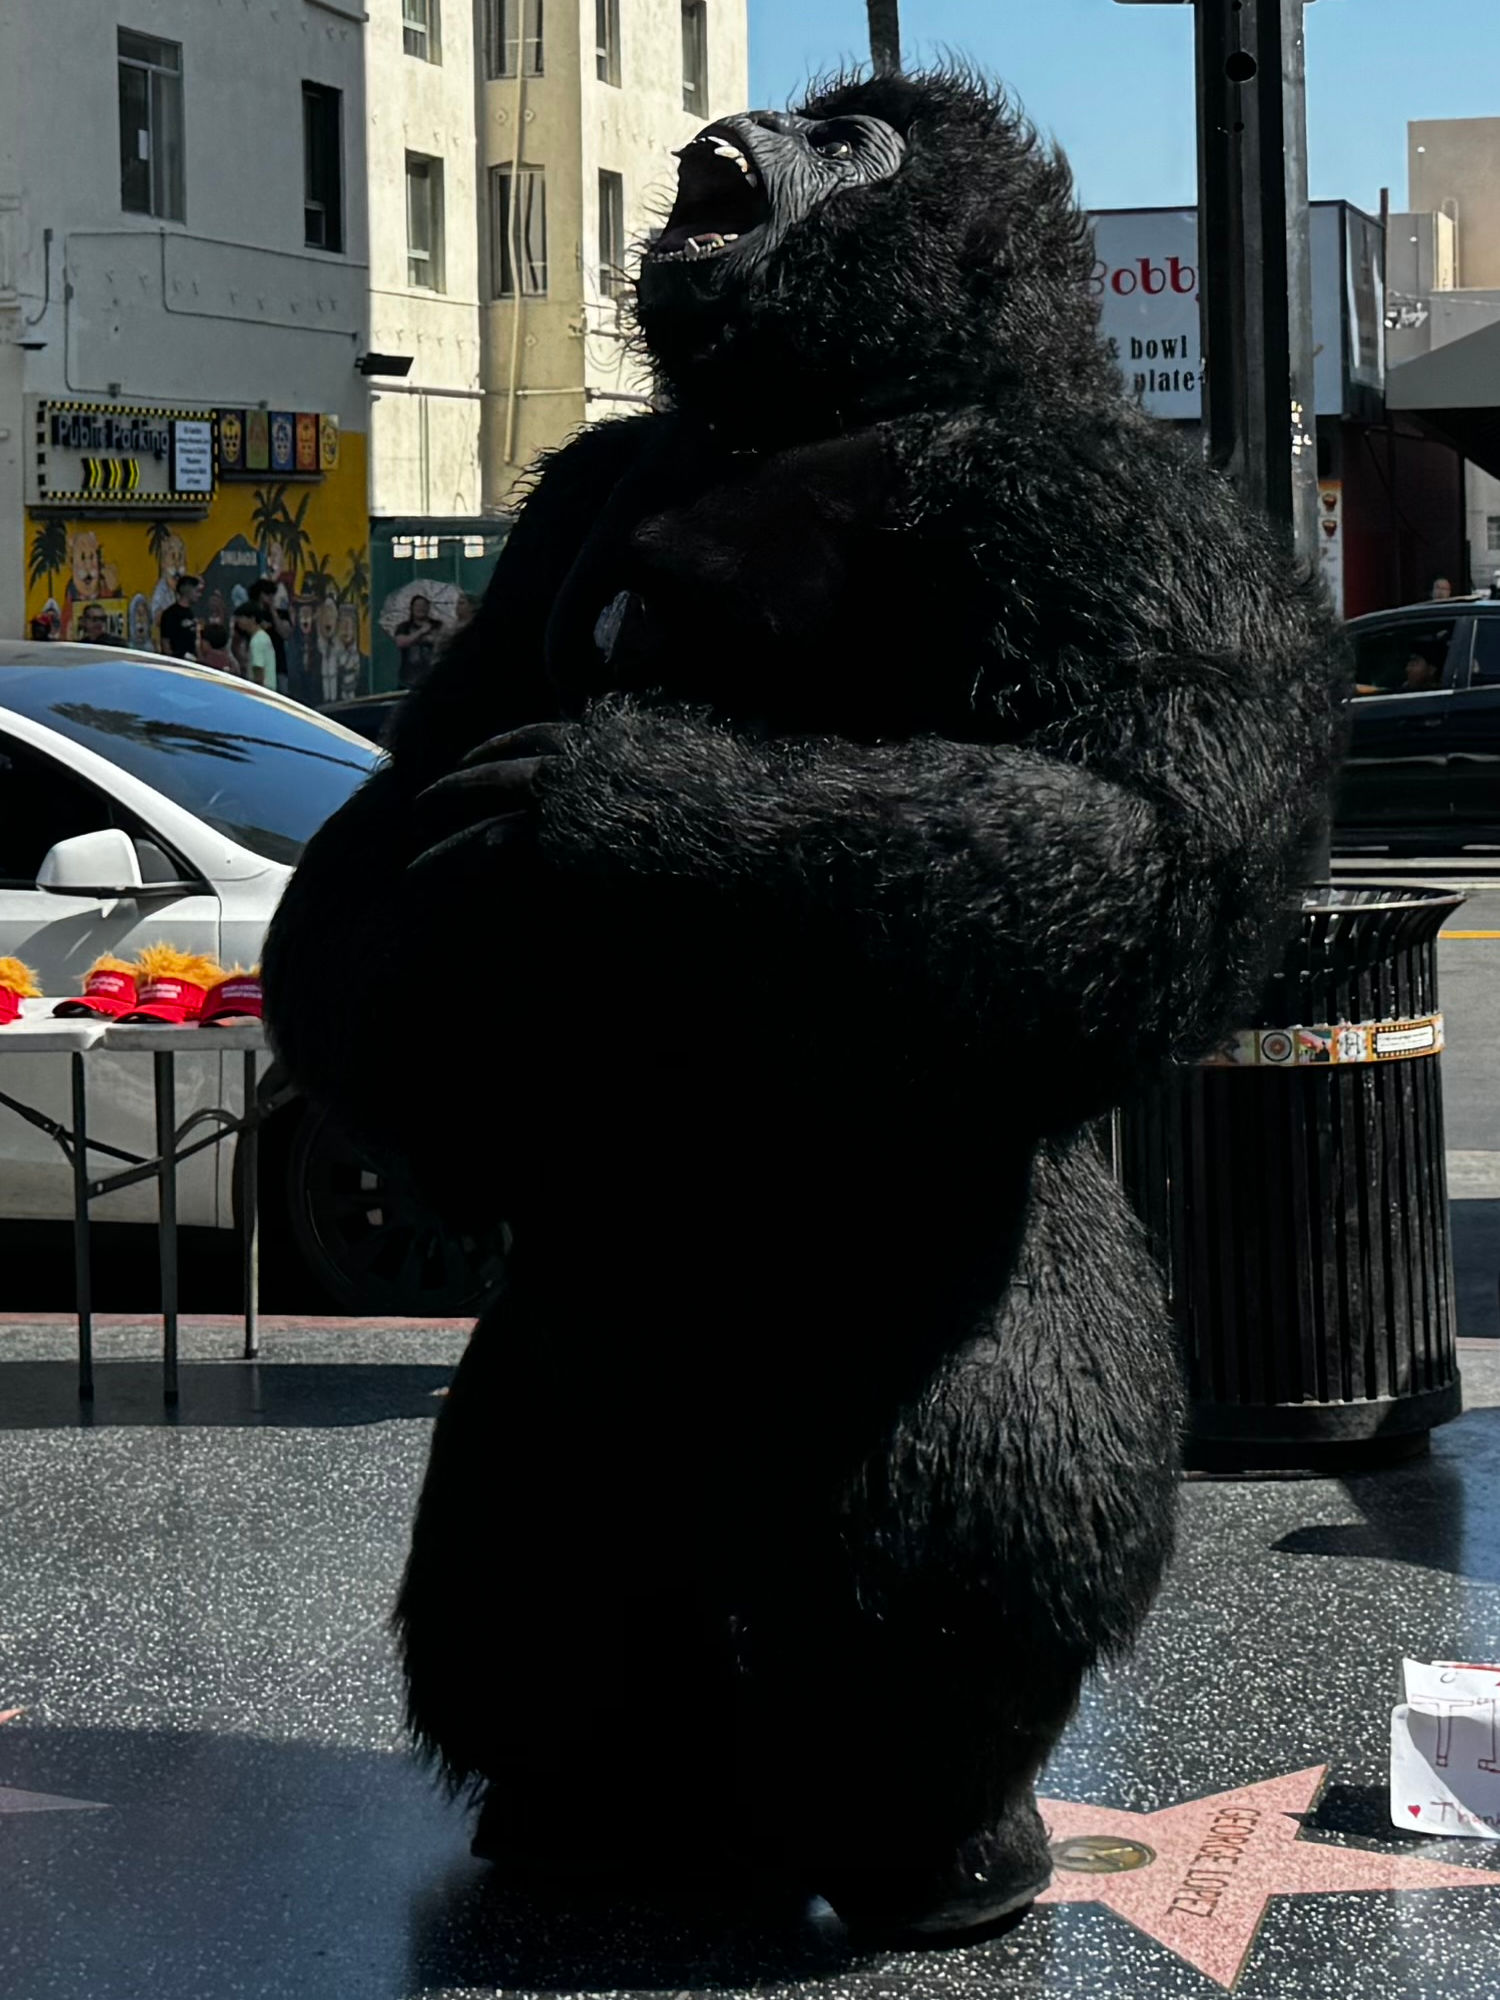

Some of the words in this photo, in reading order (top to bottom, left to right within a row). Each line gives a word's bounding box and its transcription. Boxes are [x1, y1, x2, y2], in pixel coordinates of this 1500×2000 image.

[1090, 256, 1200, 302] Bobb
[1131, 335, 1187, 359] bowl
[1134, 369, 1204, 396] plate
[59, 414, 107, 448] Public
[112, 418, 170, 457] Parking
[1189, 1807, 1262, 1865] GEORGE
[1165, 1869, 1233, 1917] LOPEZ
